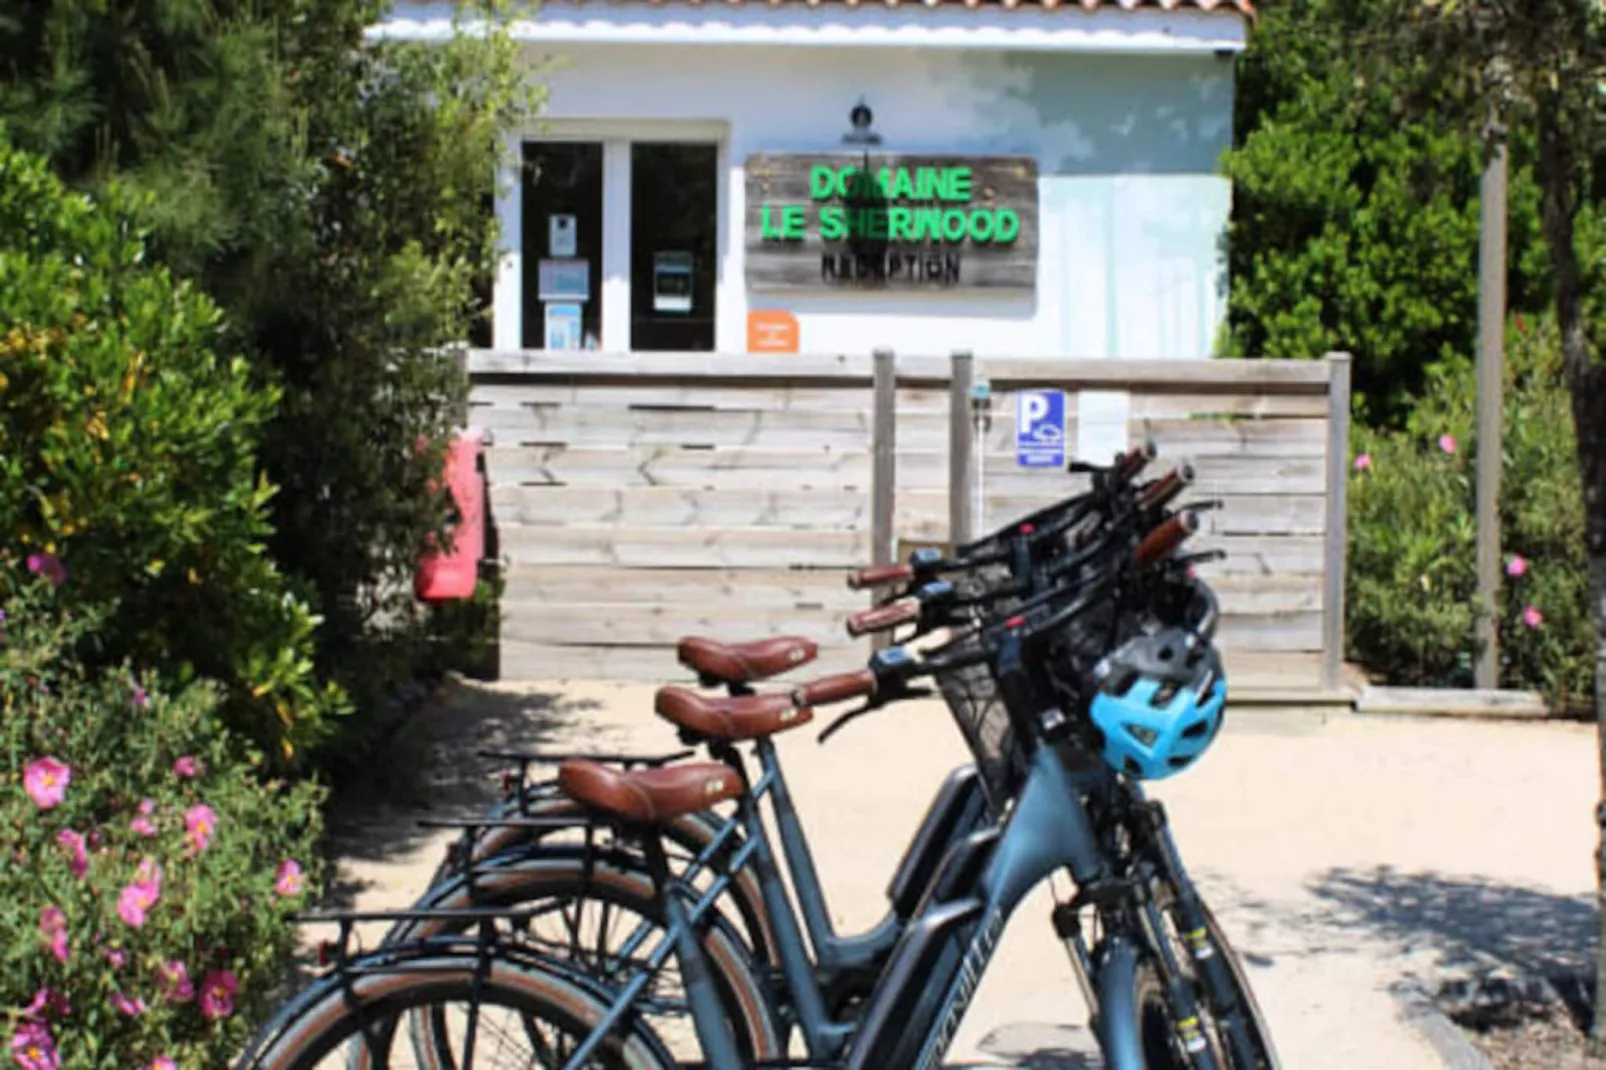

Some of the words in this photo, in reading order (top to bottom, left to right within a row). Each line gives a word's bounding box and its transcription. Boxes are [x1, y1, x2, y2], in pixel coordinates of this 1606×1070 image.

[810, 165, 973, 201] DOMAINE
[761, 203, 804, 240] LE
[819, 206, 1020, 243] SHERWOOD
[1020, 393, 1049, 433] P
